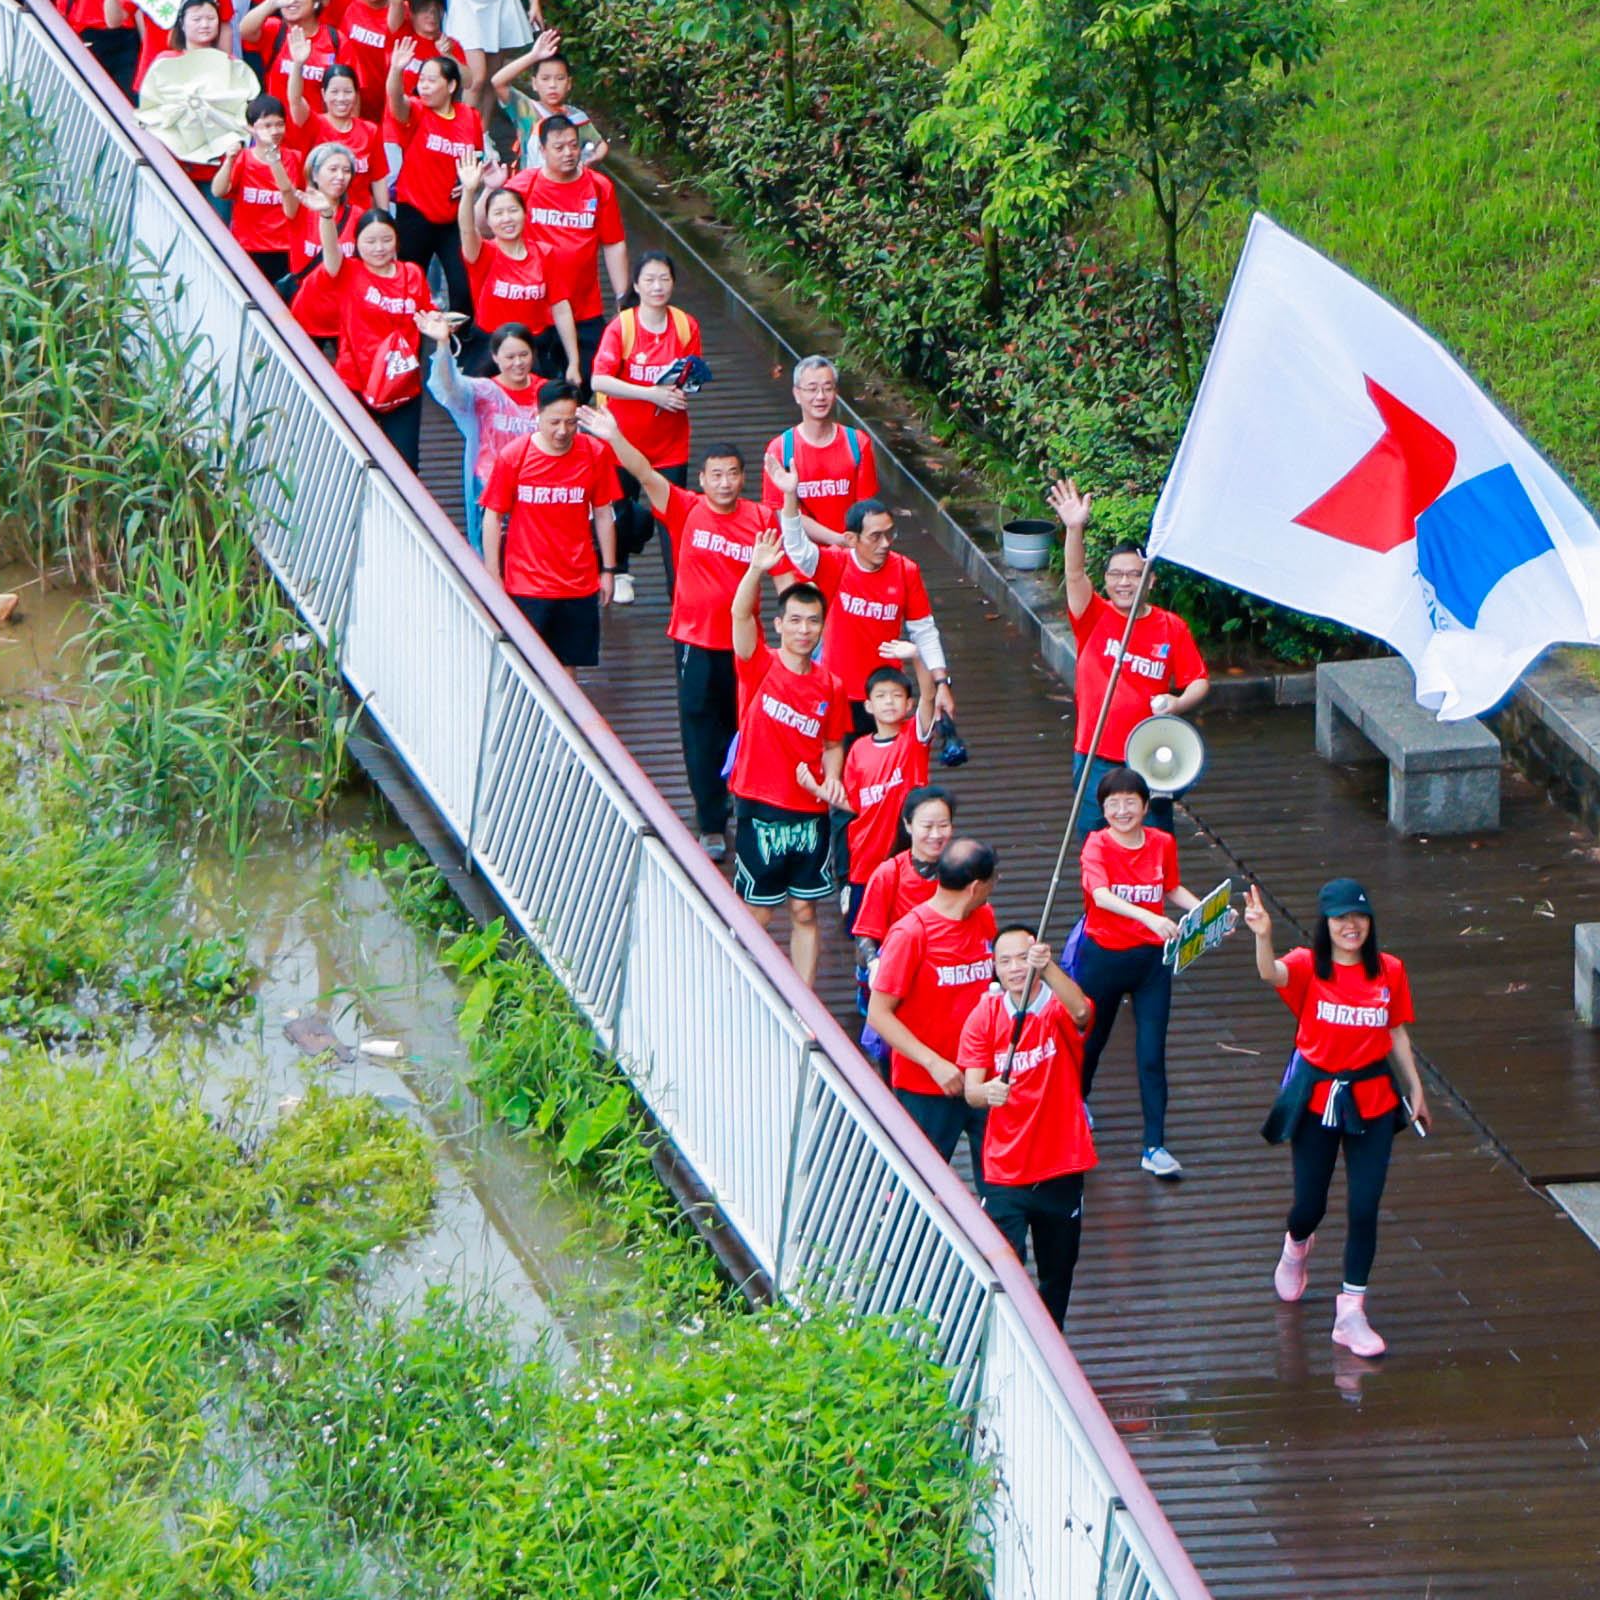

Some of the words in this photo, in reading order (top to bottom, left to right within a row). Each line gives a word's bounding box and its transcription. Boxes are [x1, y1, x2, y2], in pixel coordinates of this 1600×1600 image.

[517, 484, 585, 505] 海欣药业
[1103, 637, 1166, 681] 海药业
[1111, 884, 1162, 904] 欣药业
